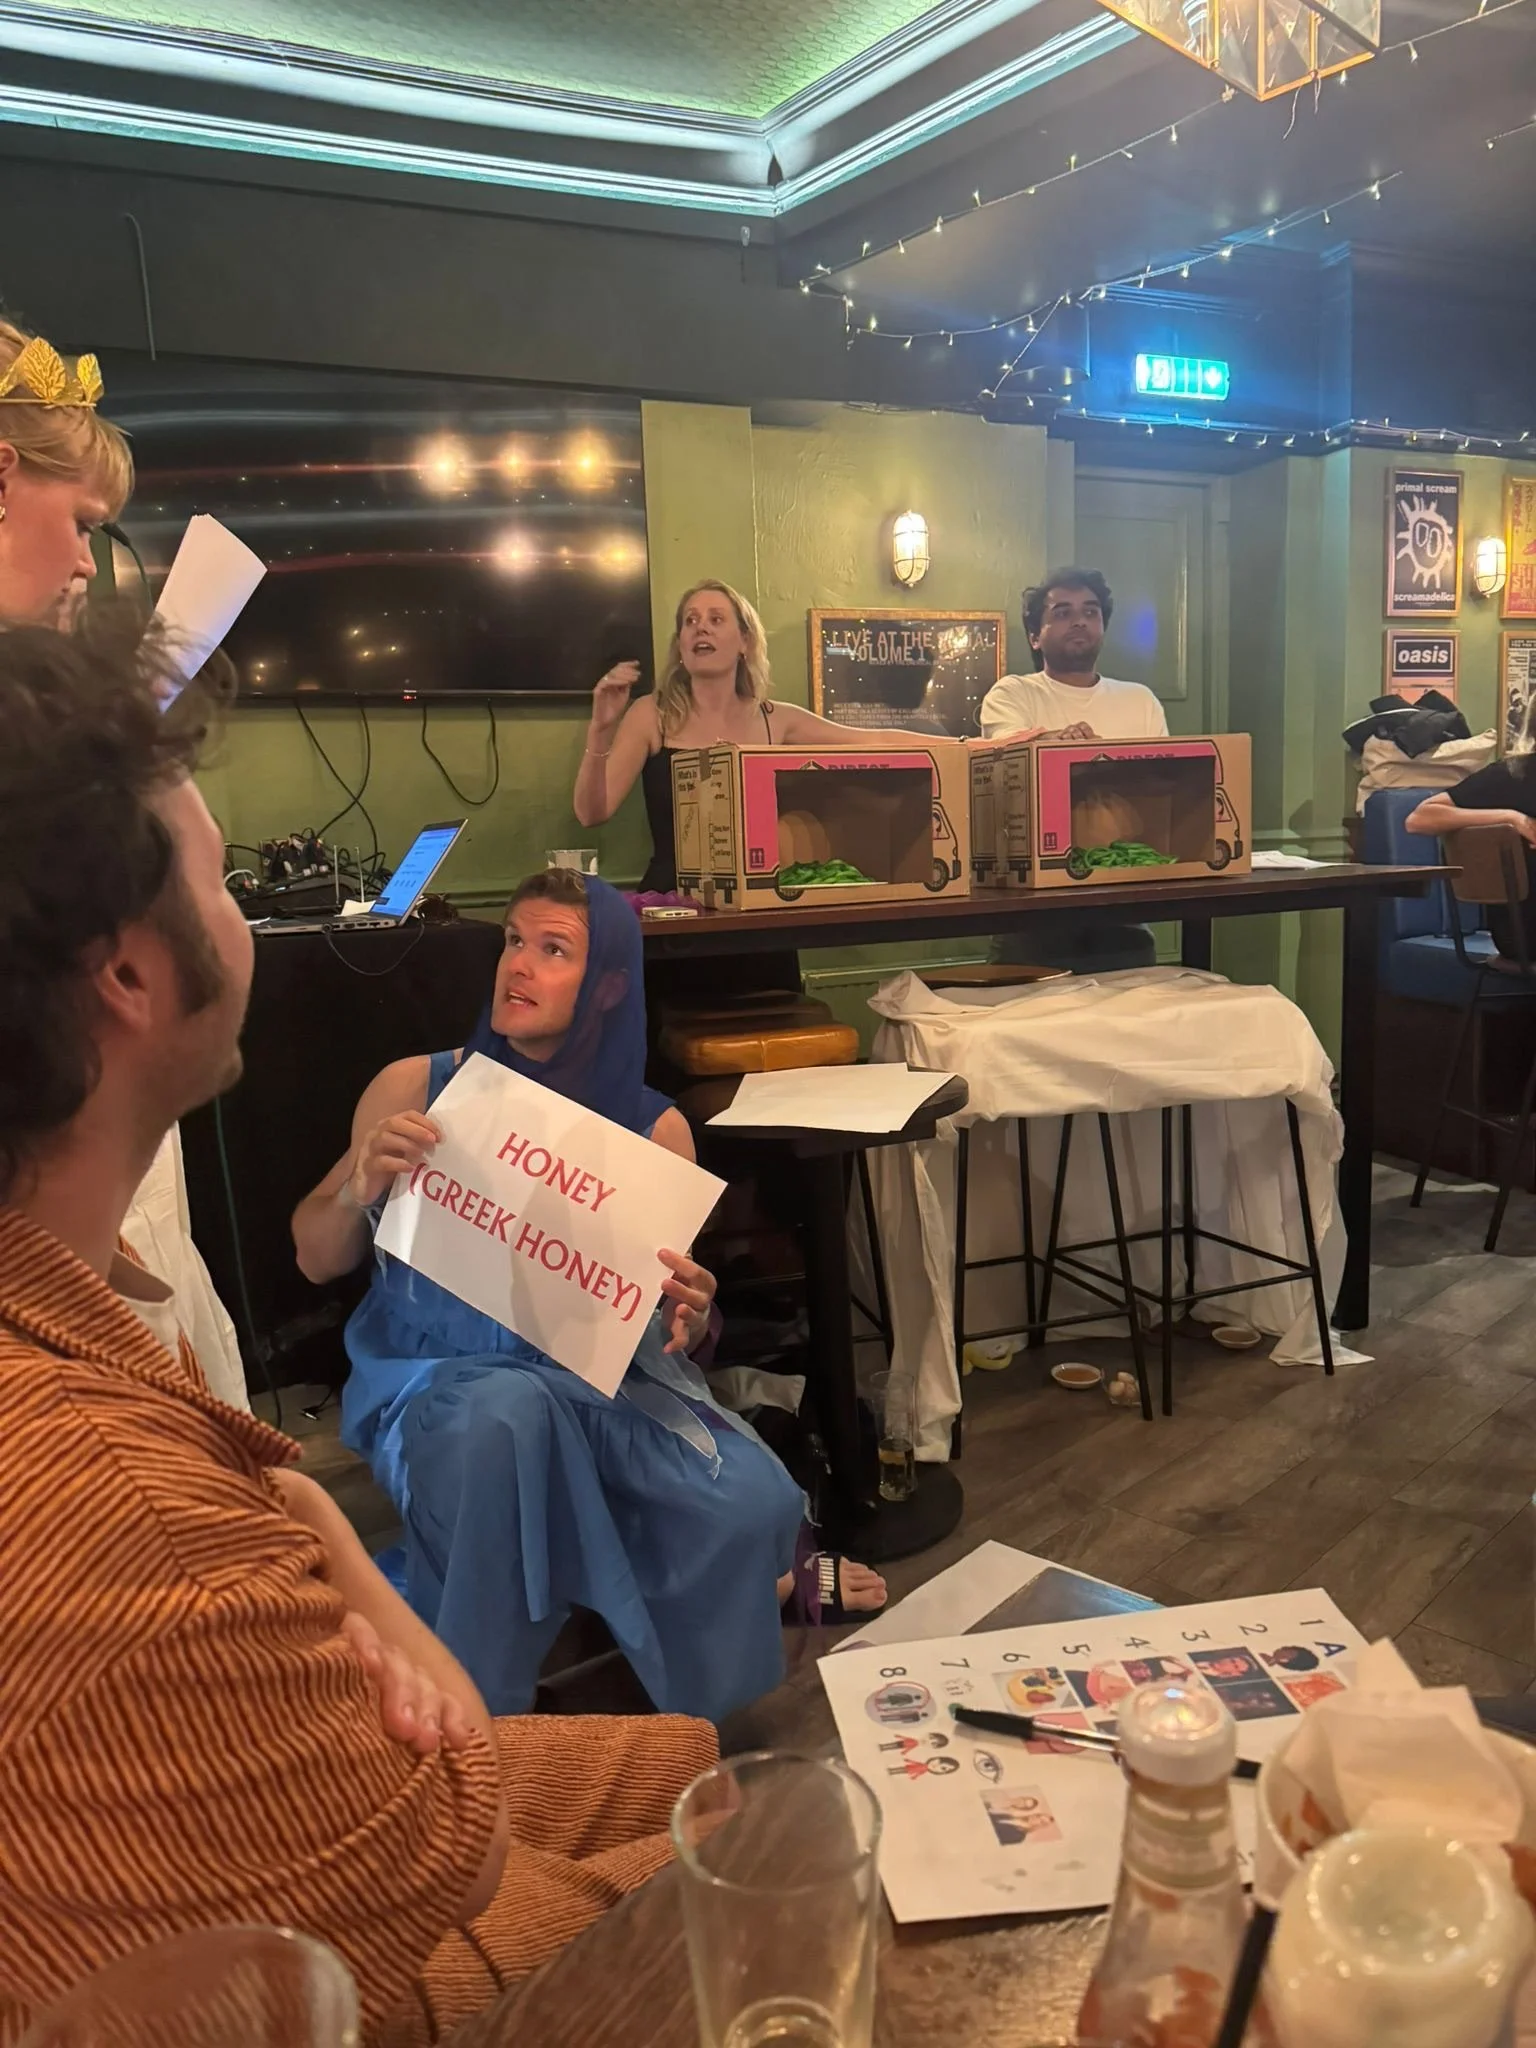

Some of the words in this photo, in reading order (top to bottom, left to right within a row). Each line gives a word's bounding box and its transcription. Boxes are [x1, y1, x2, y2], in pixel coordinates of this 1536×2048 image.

[1395, 482, 1424, 493] primal
[1425, 485, 1457, 494] scream
[1393, 592, 1456, 602] screamadelica
[832, 629, 872, 647] LIVE
[877, 631, 895, 647] AT
[900, 631, 932, 648] THE
[848, 645, 914, 662] VOLUME
[1398, 645, 1449, 664] oasis
[497, 1132, 617, 1212] HONEY
[409, 1161, 517, 1244] (GREEK
[514, 1222, 643, 1322] HONEY)
[818, 1557, 835, 1605] PUMA
[1299, 1618, 1325, 1627] 1
[1180, 1629, 1210, 1642] 3
[1238, 1623, 1269, 1637] 2
[1124, 1636, 1152, 1649] 4
[1062, 1643, 1091, 1656] 5
[1313, 1640, 1348, 1659] A
[940, 1657, 971, 1669] 7
[1002, 1651, 1030, 1664] 6
[879, 1665, 908, 1678] 8
